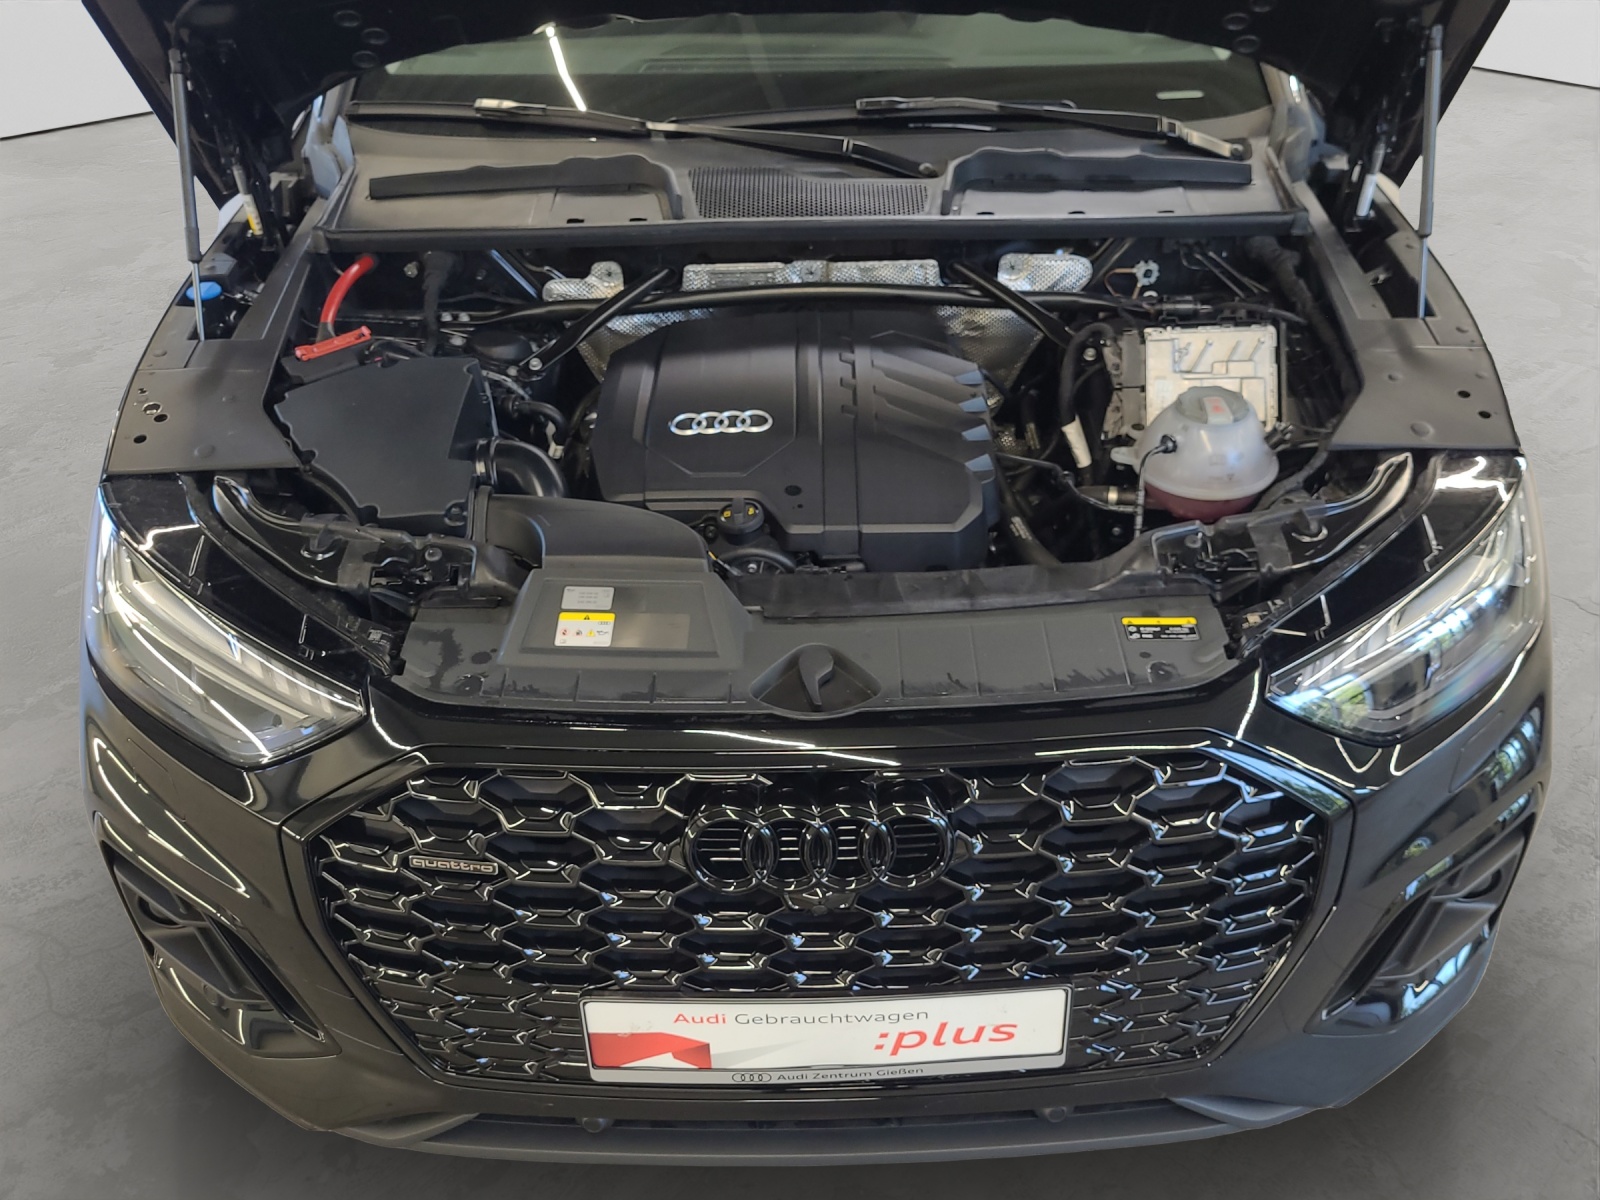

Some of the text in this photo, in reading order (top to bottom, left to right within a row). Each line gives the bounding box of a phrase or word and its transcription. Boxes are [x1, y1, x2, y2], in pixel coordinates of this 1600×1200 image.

[412, 858, 494, 873] quattro
[673, 1010, 929, 1025] Audi Gebrauchtwagen
[776, 1067, 924, 1081] Audi Zentrum Gießen
